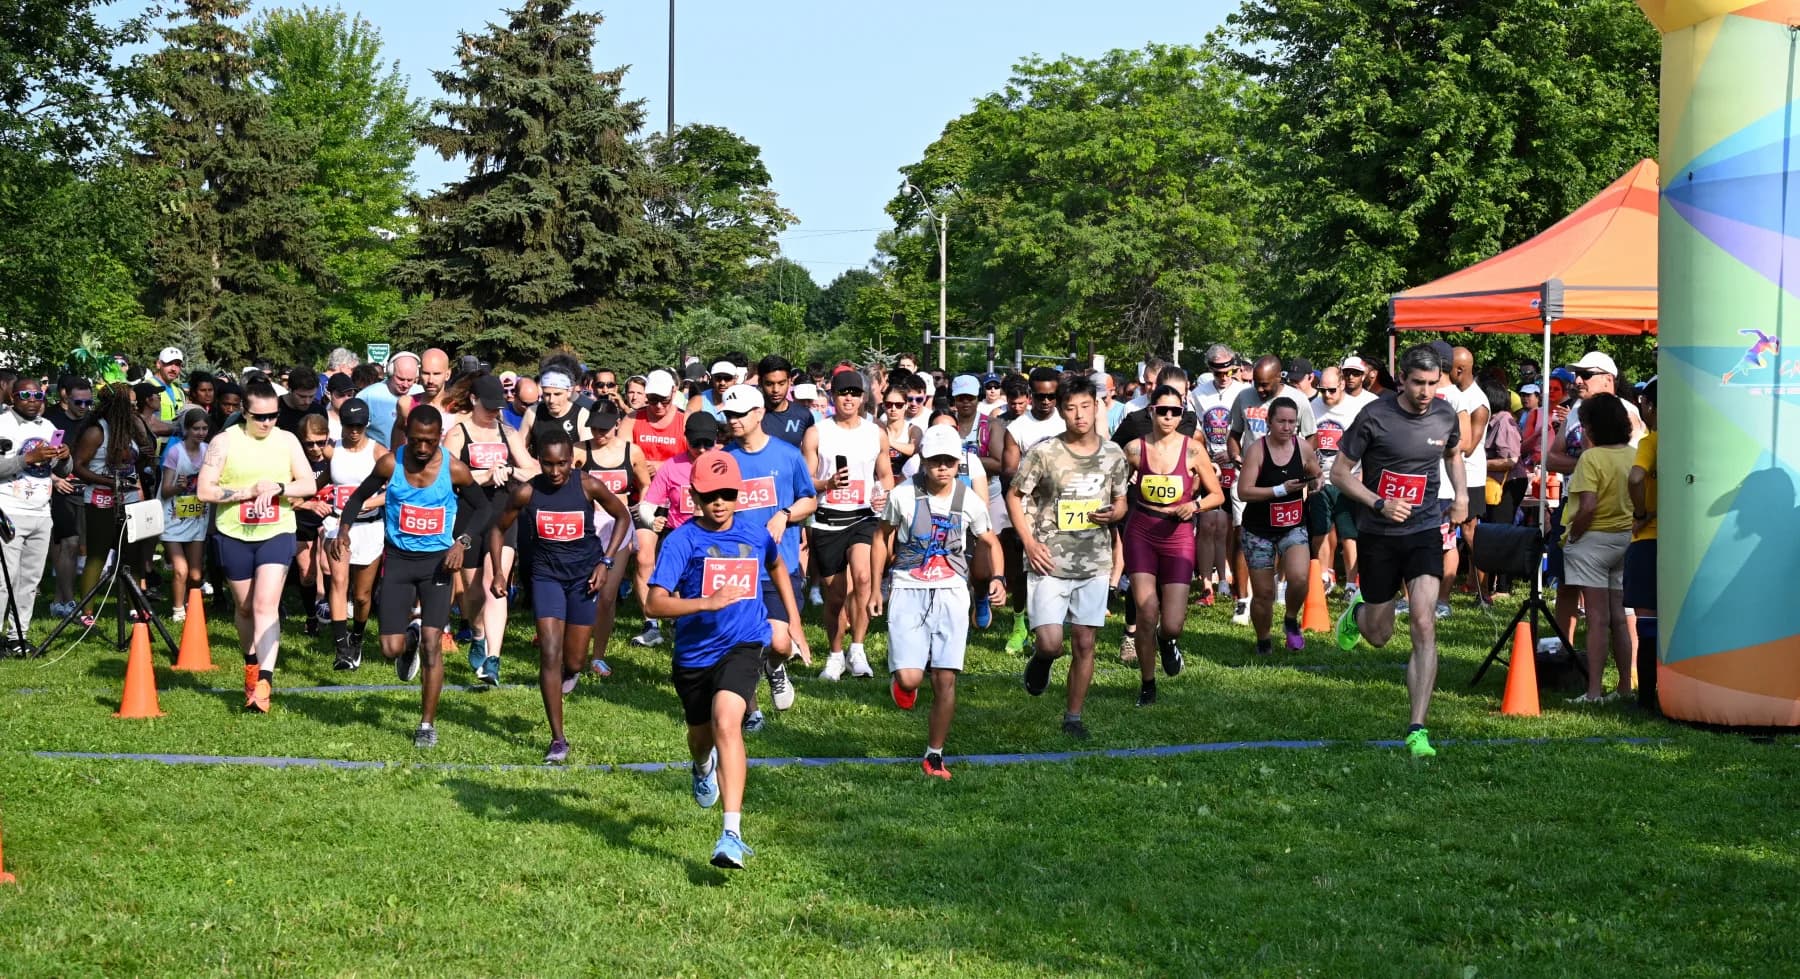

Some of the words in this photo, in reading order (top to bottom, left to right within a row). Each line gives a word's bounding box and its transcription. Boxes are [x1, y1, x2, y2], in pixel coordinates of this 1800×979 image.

[640, 434, 676, 445] CANADA
[739, 489, 769, 505] 643
[832, 488, 859, 500] 654
[1147, 485, 1176, 498] 709
[1384, 483, 1418, 500] 214
[1276, 509, 1299, 523] 213
[405, 516, 438, 530] 695
[544, 523, 577, 535] 575
[710, 563, 726, 571] 10K
[712, 574, 751, 590] 644
